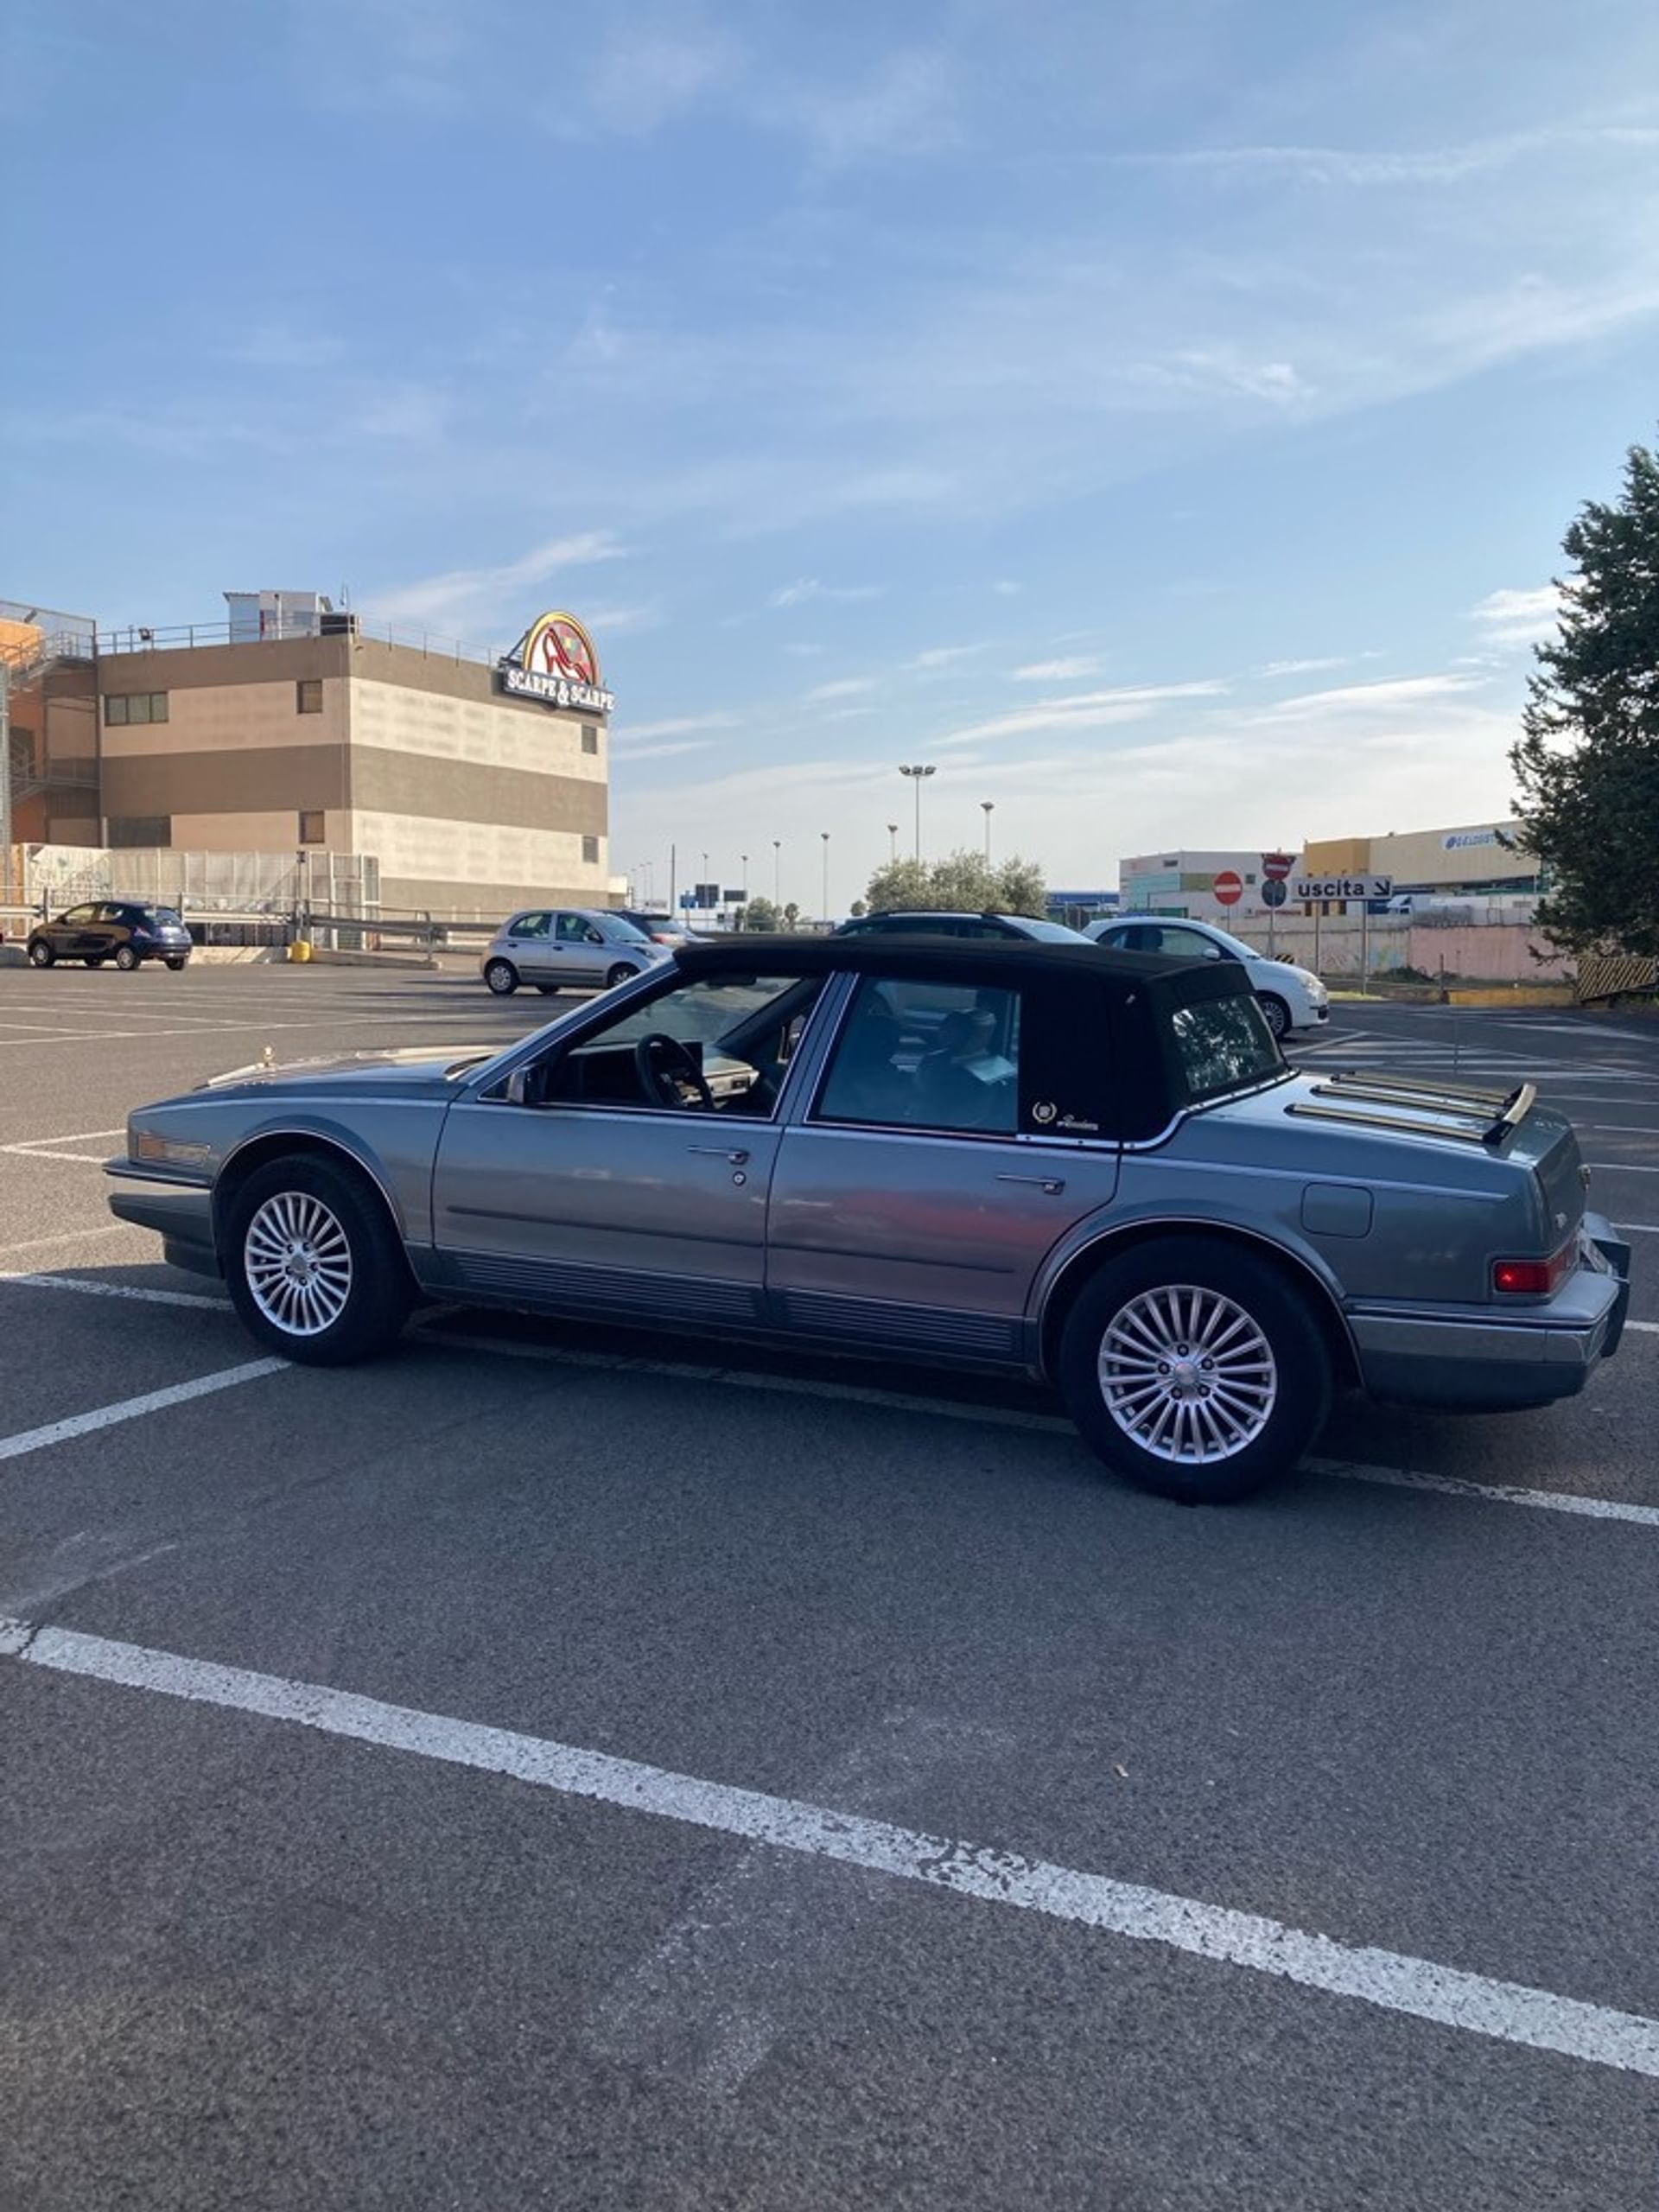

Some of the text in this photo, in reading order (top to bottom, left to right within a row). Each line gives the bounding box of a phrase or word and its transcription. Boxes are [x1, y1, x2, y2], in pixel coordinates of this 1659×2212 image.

[507, 670, 615, 709] SCARPE & SCARPE
[1298, 879, 1364, 898] uscita
